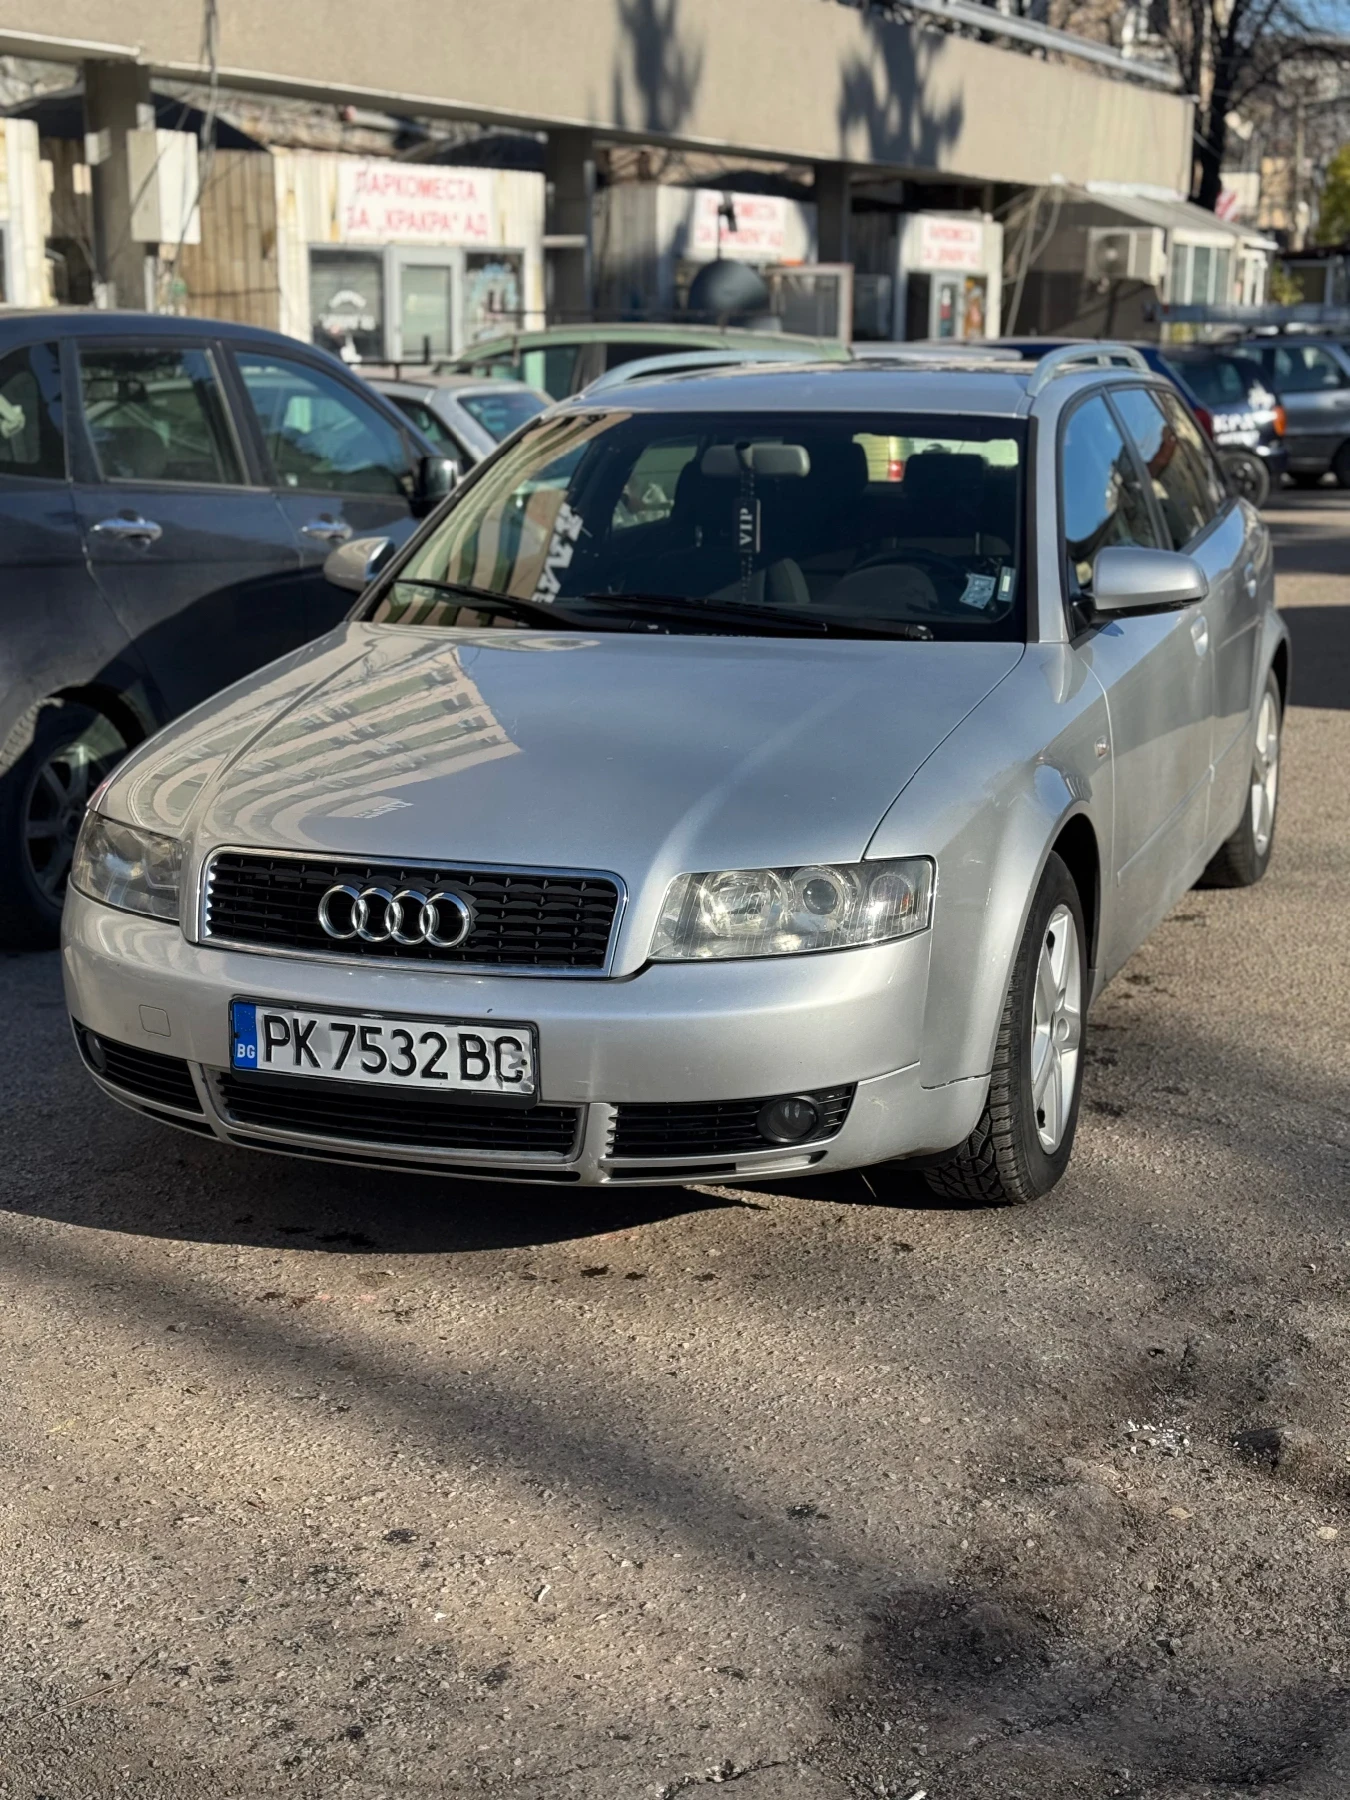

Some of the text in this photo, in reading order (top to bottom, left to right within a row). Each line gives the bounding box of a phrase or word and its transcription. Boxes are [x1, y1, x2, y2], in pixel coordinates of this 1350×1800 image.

[356, 171, 478, 203] ПАРКОМЕСТА
[739, 507, 753, 546] VIP
[237, 1043, 256, 1059] BG
[263, 1014, 524, 1083] PK 7532 BC
